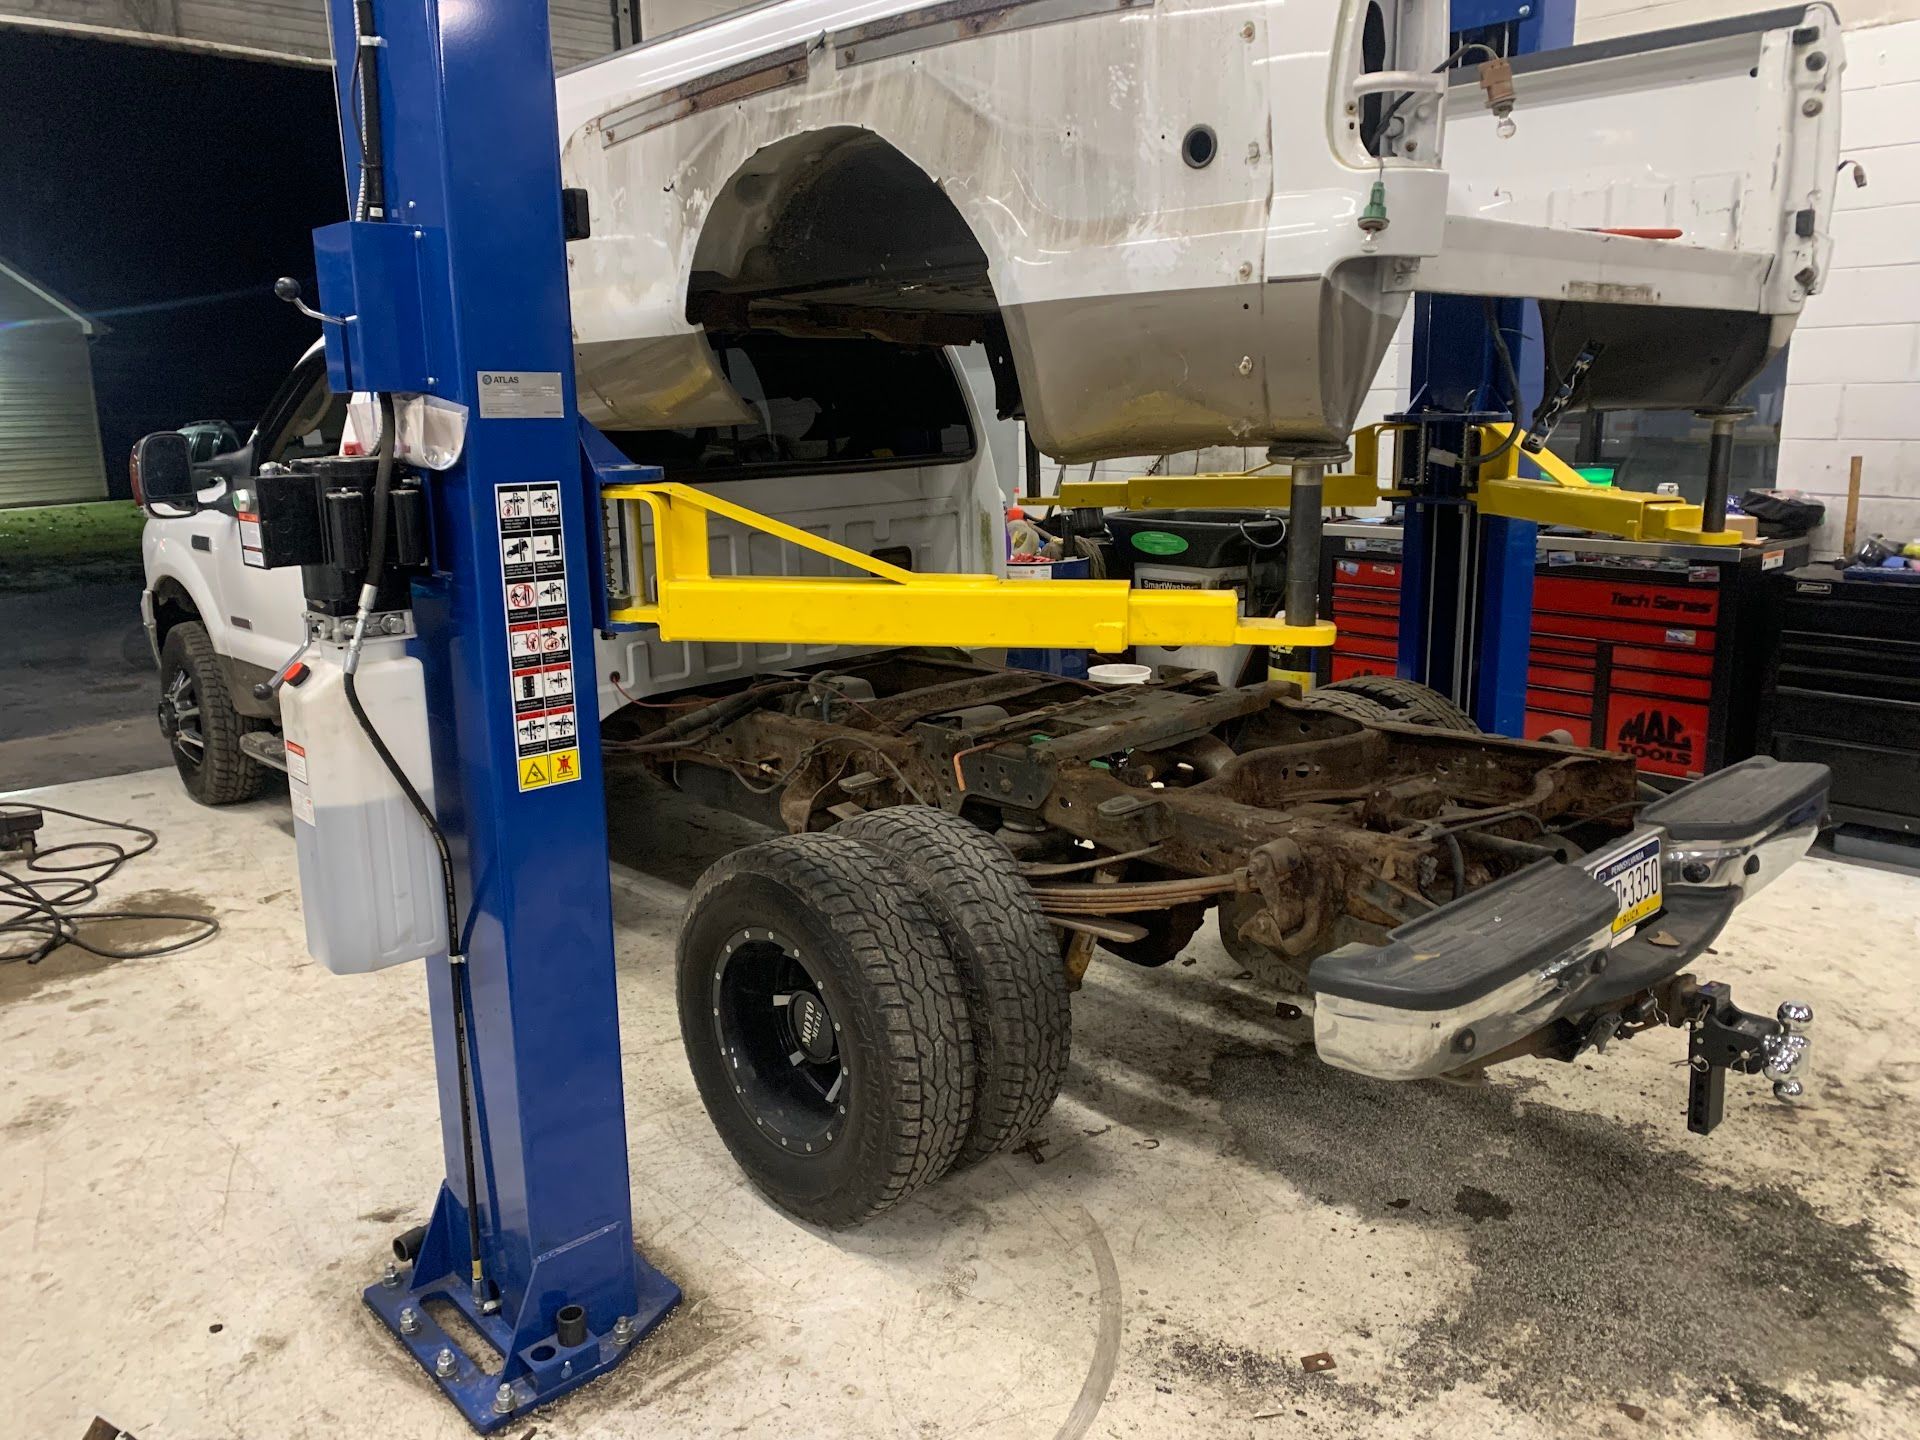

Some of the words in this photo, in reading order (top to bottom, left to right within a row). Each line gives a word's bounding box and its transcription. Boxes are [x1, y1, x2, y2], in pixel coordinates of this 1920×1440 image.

[493, 376, 519, 384] ATLAS
[1143, 580, 1195, 590] SmartWashe
[1611, 592, 1650, 608] Tech
[1652, 595, 1713, 613] Series
[1618, 710, 1692, 751] MAC
[1618, 744, 1692, 765] TOOLS
[1611, 850, 1645, 876] PENNSYLVANIA
[1619, 907, 1640, 925] TRUCK
[802, 1001, 815, 1047] MOTO
